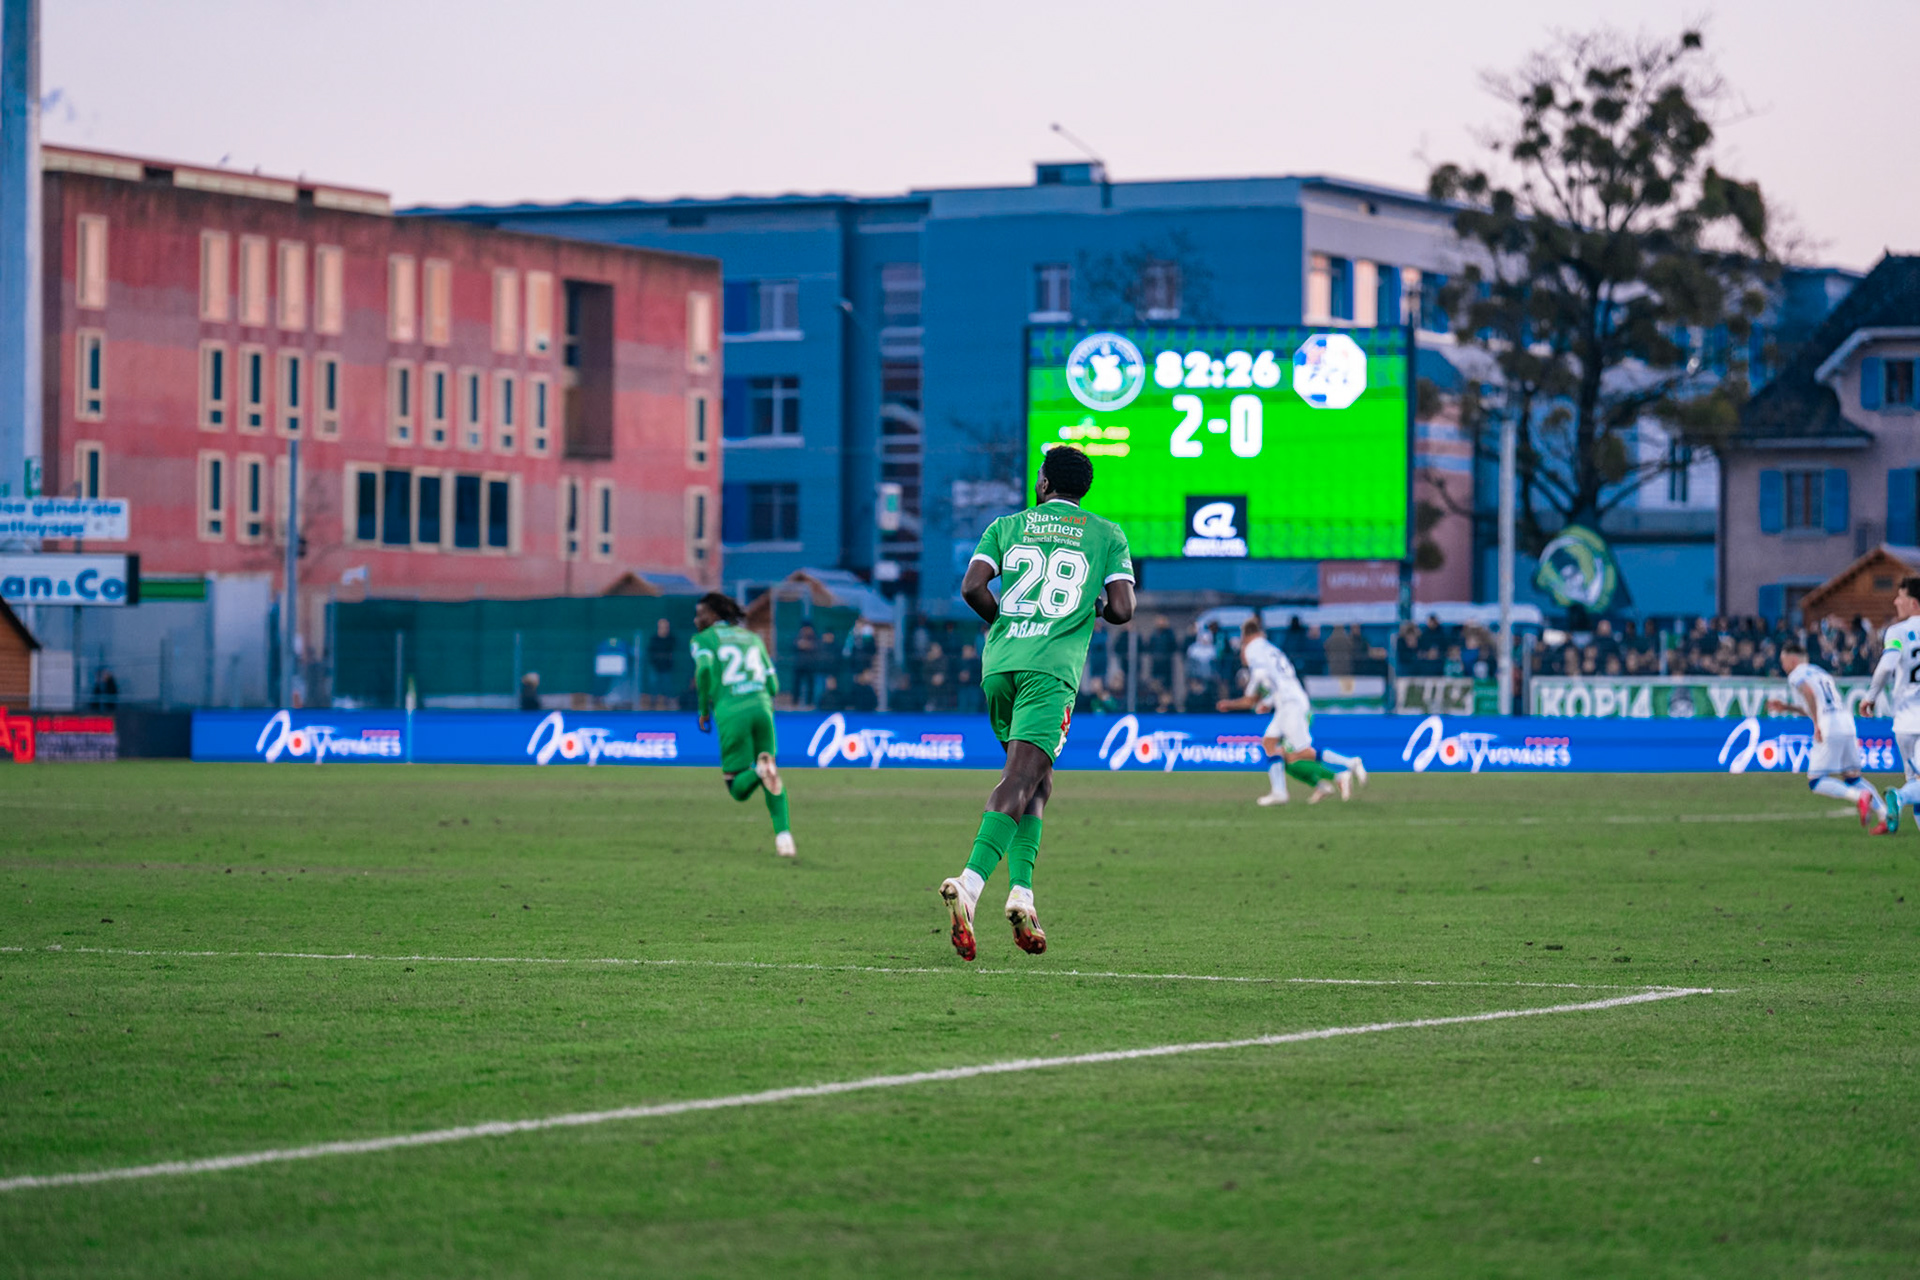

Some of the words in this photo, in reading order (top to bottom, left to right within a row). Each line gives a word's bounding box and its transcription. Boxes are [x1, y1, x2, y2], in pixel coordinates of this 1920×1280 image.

[1154, 350, 1281, 388] 82:26
[1170, 394, 1263, 458] 2-0
[1024, 523, 1084, 538] Partners
[1026, 512, 1062, 523] Shaw
[1023, 535, 1052, 543] Financial
[1053, 536, 1081, 547] Services
[1000, 544, 1089, 618] 28
[717, 644, 766, 687] 24
[1539, 687, 1654, 717] KOP14
